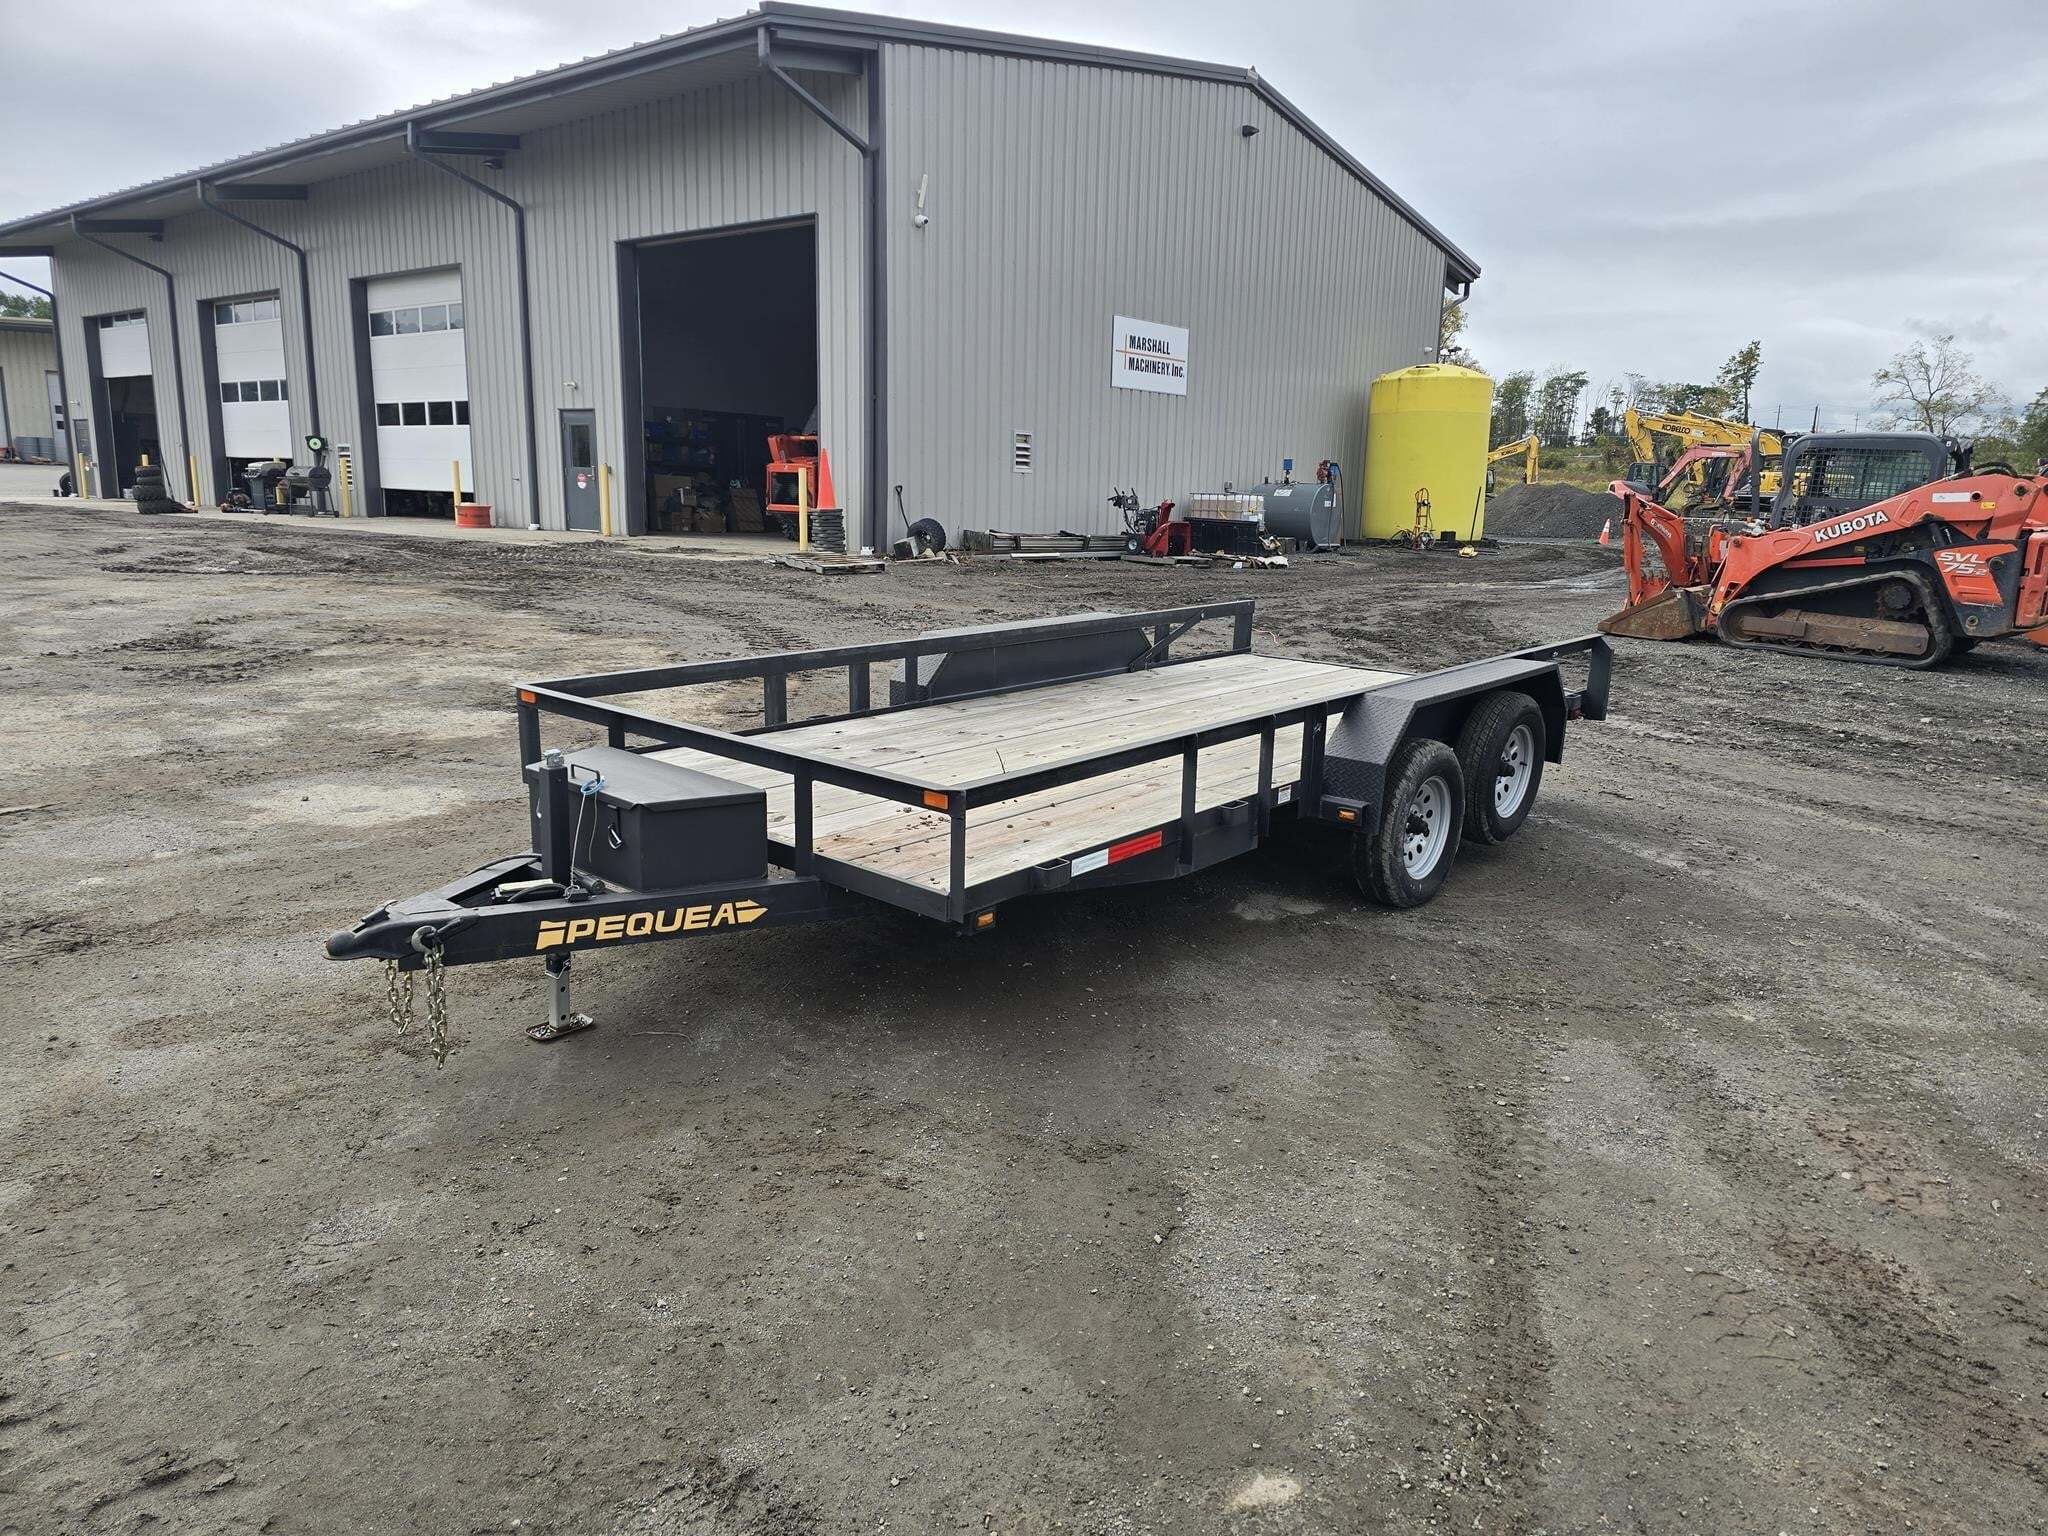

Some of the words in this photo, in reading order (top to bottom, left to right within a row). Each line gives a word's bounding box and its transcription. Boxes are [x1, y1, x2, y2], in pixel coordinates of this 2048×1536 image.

[1129, 335, 1171, 355] MARSHALL
[1171, 363, 1185, 378] Inc.
[1662, 423, 1690, 434] KOBELCO
[1814, 510, 1889, 543] KUBOTA
[1937, 551, 1985, 564] SVL
[566, 902, 736, 944] PEQUEA
